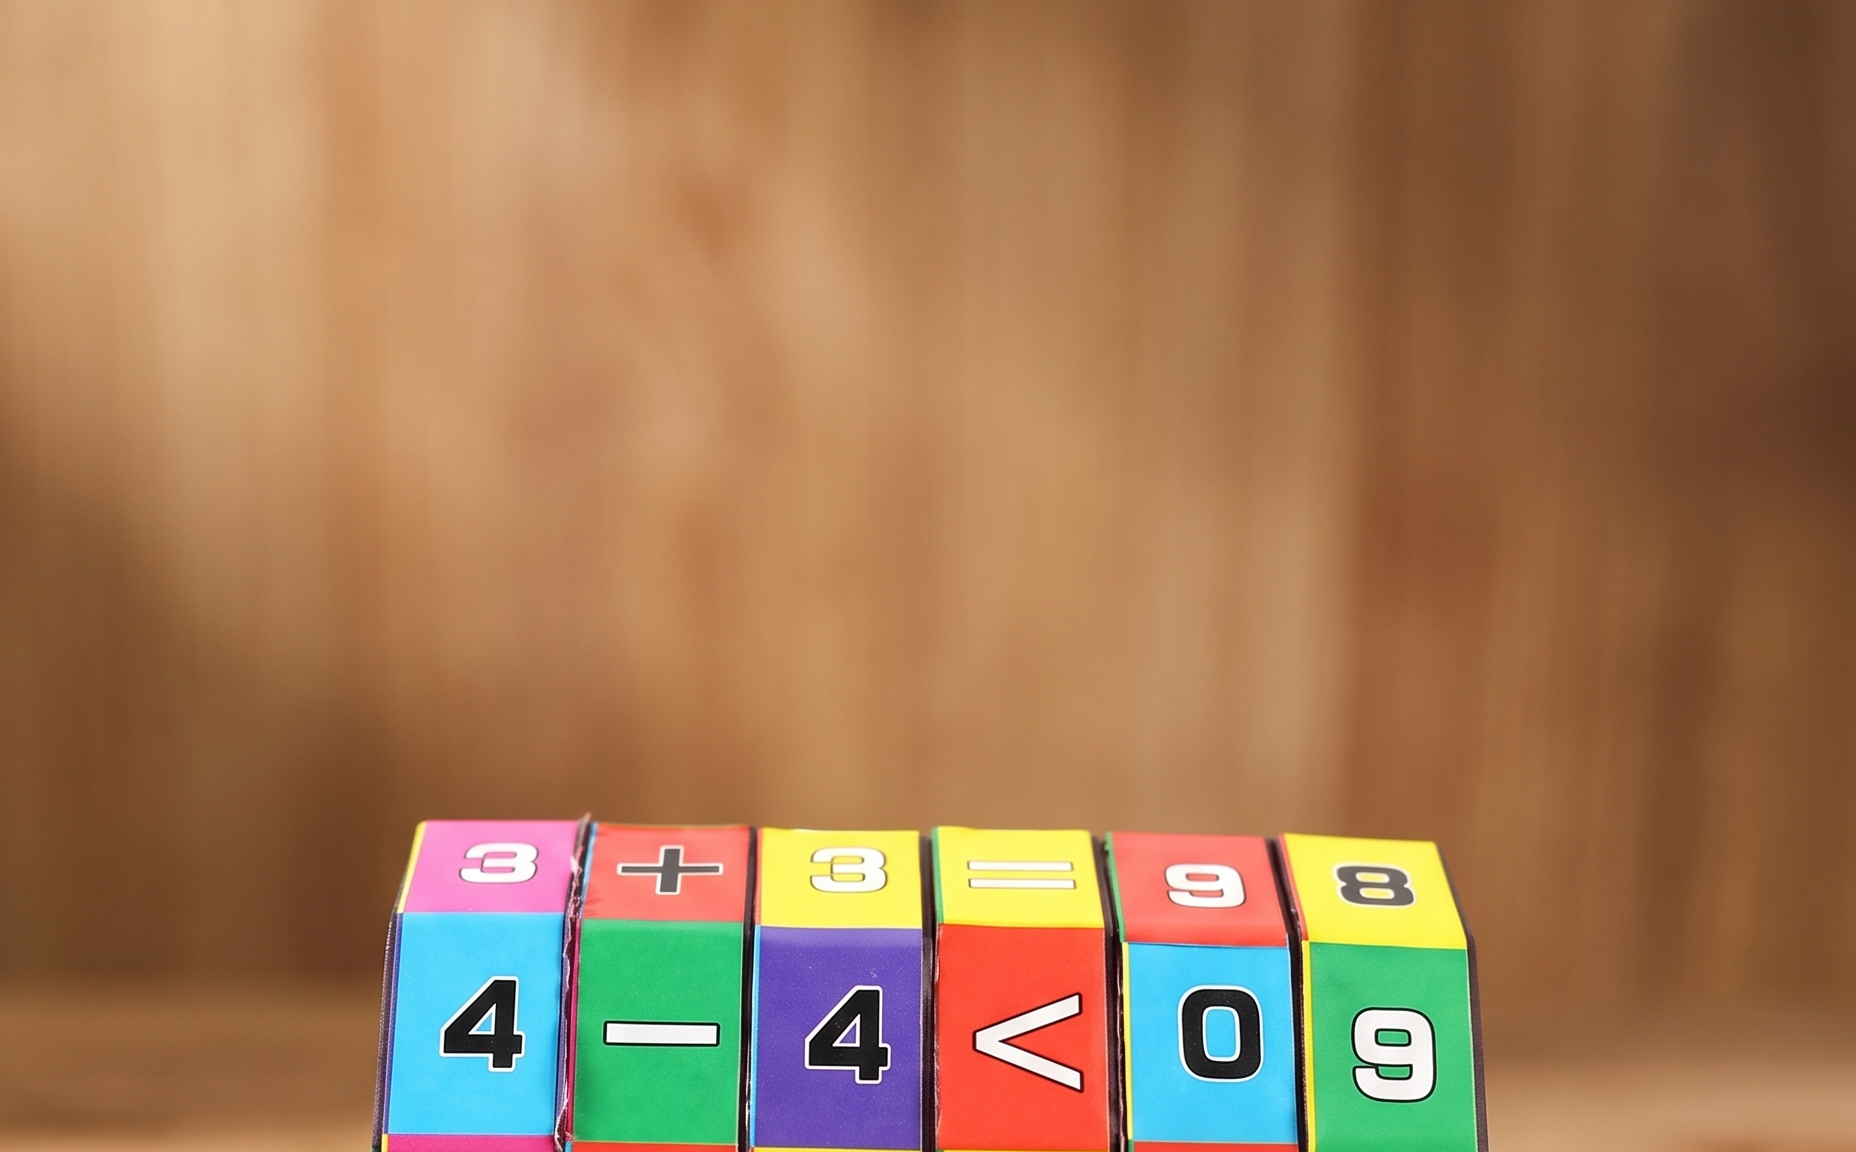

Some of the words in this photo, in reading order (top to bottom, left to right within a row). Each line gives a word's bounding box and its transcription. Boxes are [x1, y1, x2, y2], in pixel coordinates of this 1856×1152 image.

[459, 843, 539, 884] 3
[617, 845, 723, 895] +
[809, 846, 888, 893] 3
[968, 860, 1076, 889] =
[1165, 863, 1246, 908] 9
[1332, 863, 1417, 908] 8
[439, 976, 525, 1072] 4
[804, 985, 891, 1085] 4
[973, 992, 1084, 1093] <
[1177, 985, 1264, 1082] 0
[1351, 1007, 1437, 1103] 9
